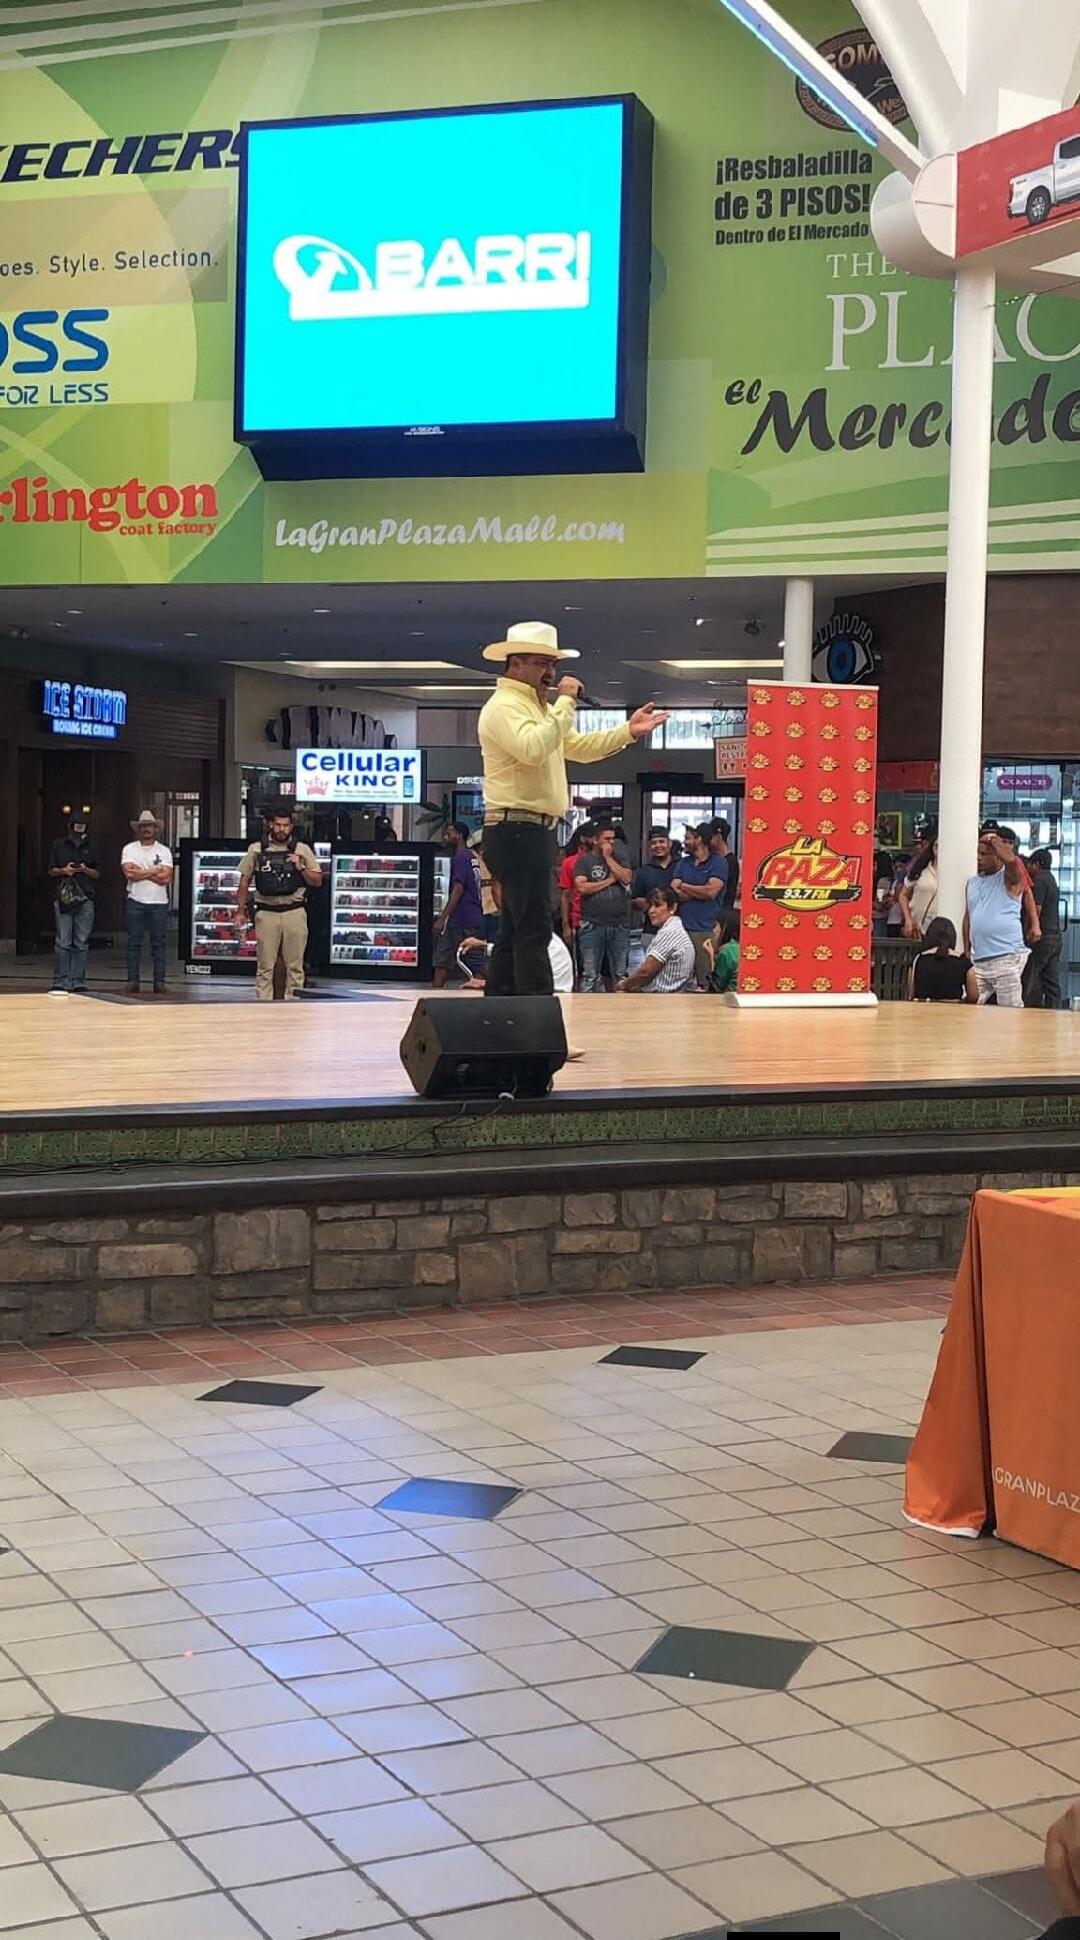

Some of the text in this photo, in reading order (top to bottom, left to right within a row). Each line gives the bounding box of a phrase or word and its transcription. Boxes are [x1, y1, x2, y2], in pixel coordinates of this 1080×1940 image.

[0, 129, 240, 184] ECHER
[716, 149, 872, 185] ¡Resbaladilla
[714, 183, 871, 221] de 3 PISOS!
[715, 221, 869, 245] Dentro de El Mercado
[49, 252, 105, 278] Style.
[114, 248, 219, 270] Selection.
[375, 231, 591, 289] BARRI
[826, 252, 910, 279] THE
[0, 309, 109, 374] SS
[824, 289, 1080, 371] PLC
[50, 383, 108, 404] LESS
[724, 373, 1080, 456] El Mercdo
[119, 521, 217, 536] coat factory
[275, 515, 625, 554] LaGranPlazaMall.com
[43, 679, 127, 725] ICE STORM
[302, 752, 416, 772] Cellular
[336, 774, 397, 787] KING
[1000, 778, 1047, 786] COACH
[790, 837, 825, 855] LA
[759, 856, 861, 887] RAZA
[783, 889, 832, 899] 93.7 FM
[991, 1465, 1080, 1513] GRANPLAZ
